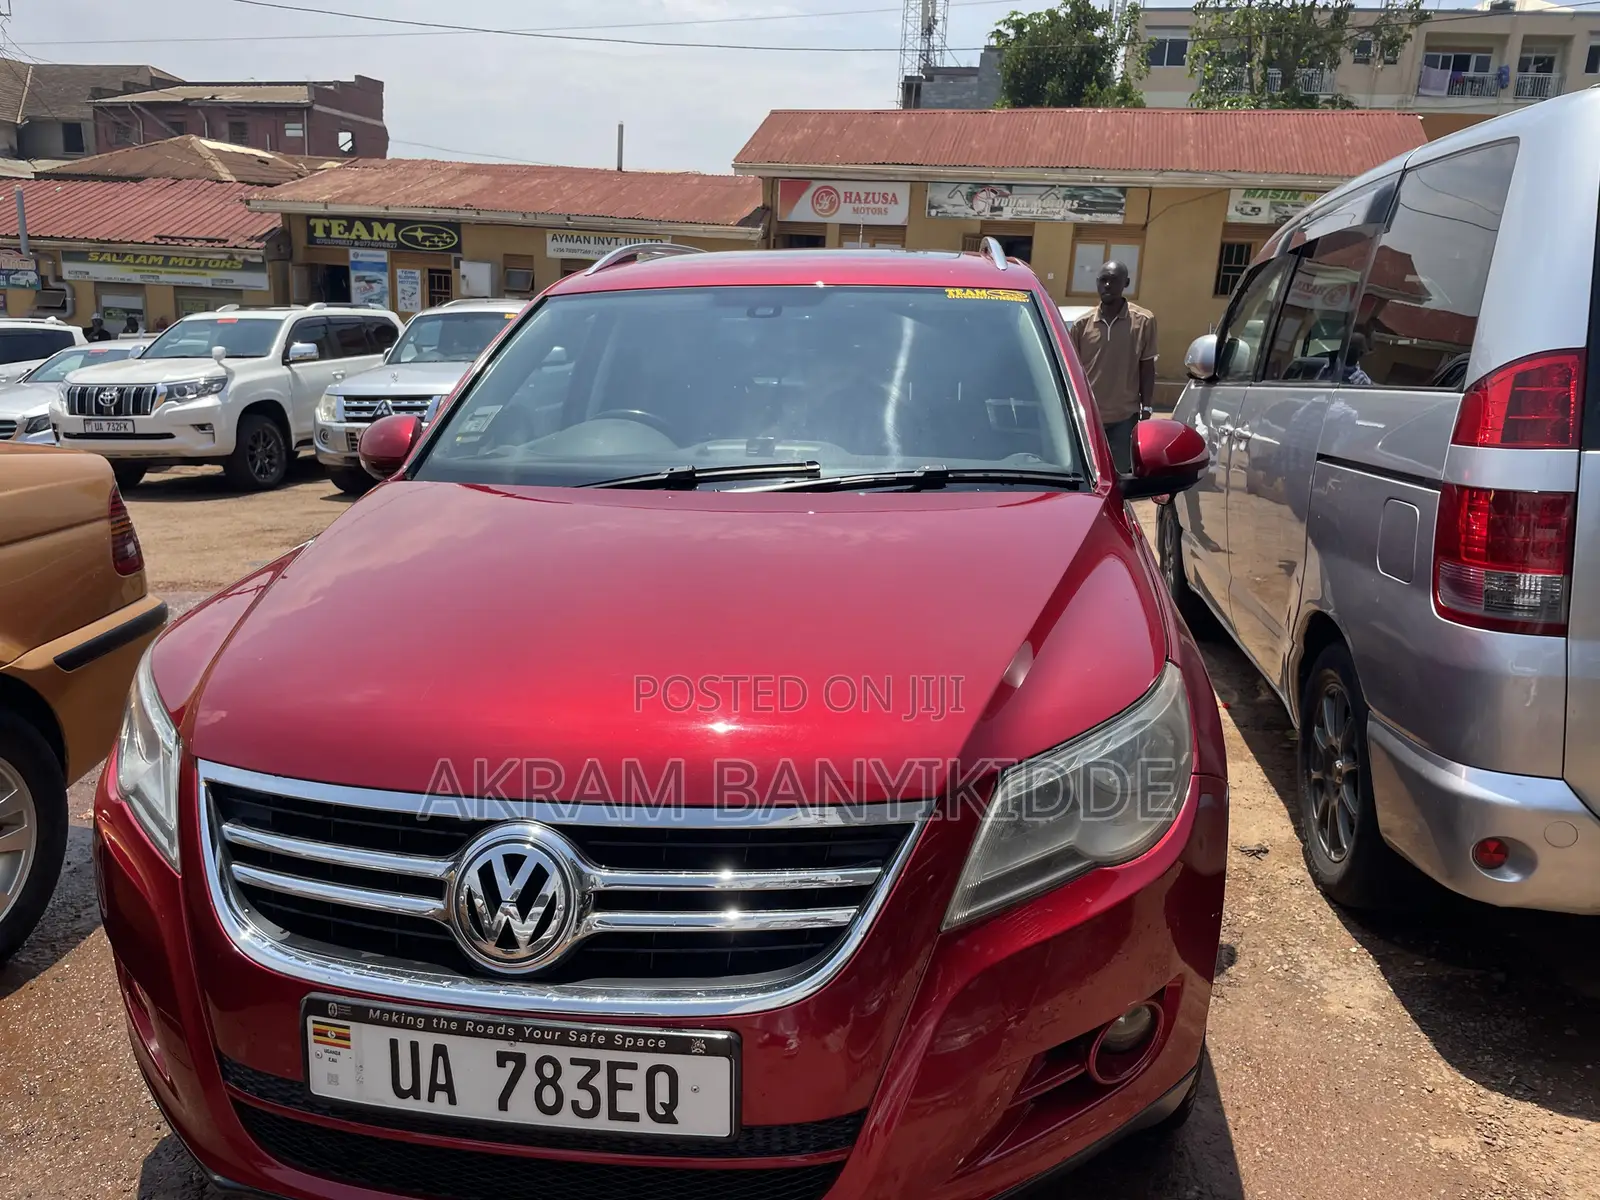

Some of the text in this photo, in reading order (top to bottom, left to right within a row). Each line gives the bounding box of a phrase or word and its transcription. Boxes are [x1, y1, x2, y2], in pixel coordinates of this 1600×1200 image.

[843, 191, 899, 205] HAZUSA
[1242, 189, 1300, 200] MASIN
[1030, 199, 1079, 209] MOTORS
[852, 206, 888, 216] MOTORS
[309, 218, 397, 242] TEAM
[551, 233, 591, 245] AYMAN
[593, 236, 622, 246] INVT.
[88, 252, 243, 269] SALAAM MOTORS
[945, 288, 987, 297] TEAM
[94, 422, 103, 431] UA
[368, 1008, 425, 1028] Making
[433, 1017, 458, 1031] the
[465, 1020, 515, 1036] Roads
[523, 1026, 562, 1040] Your
[568, 1031, 606, 1044] Safe
[614, 1033, 667, 1049] Space
[389, 1037, 679, 1125] UA 783EQ
